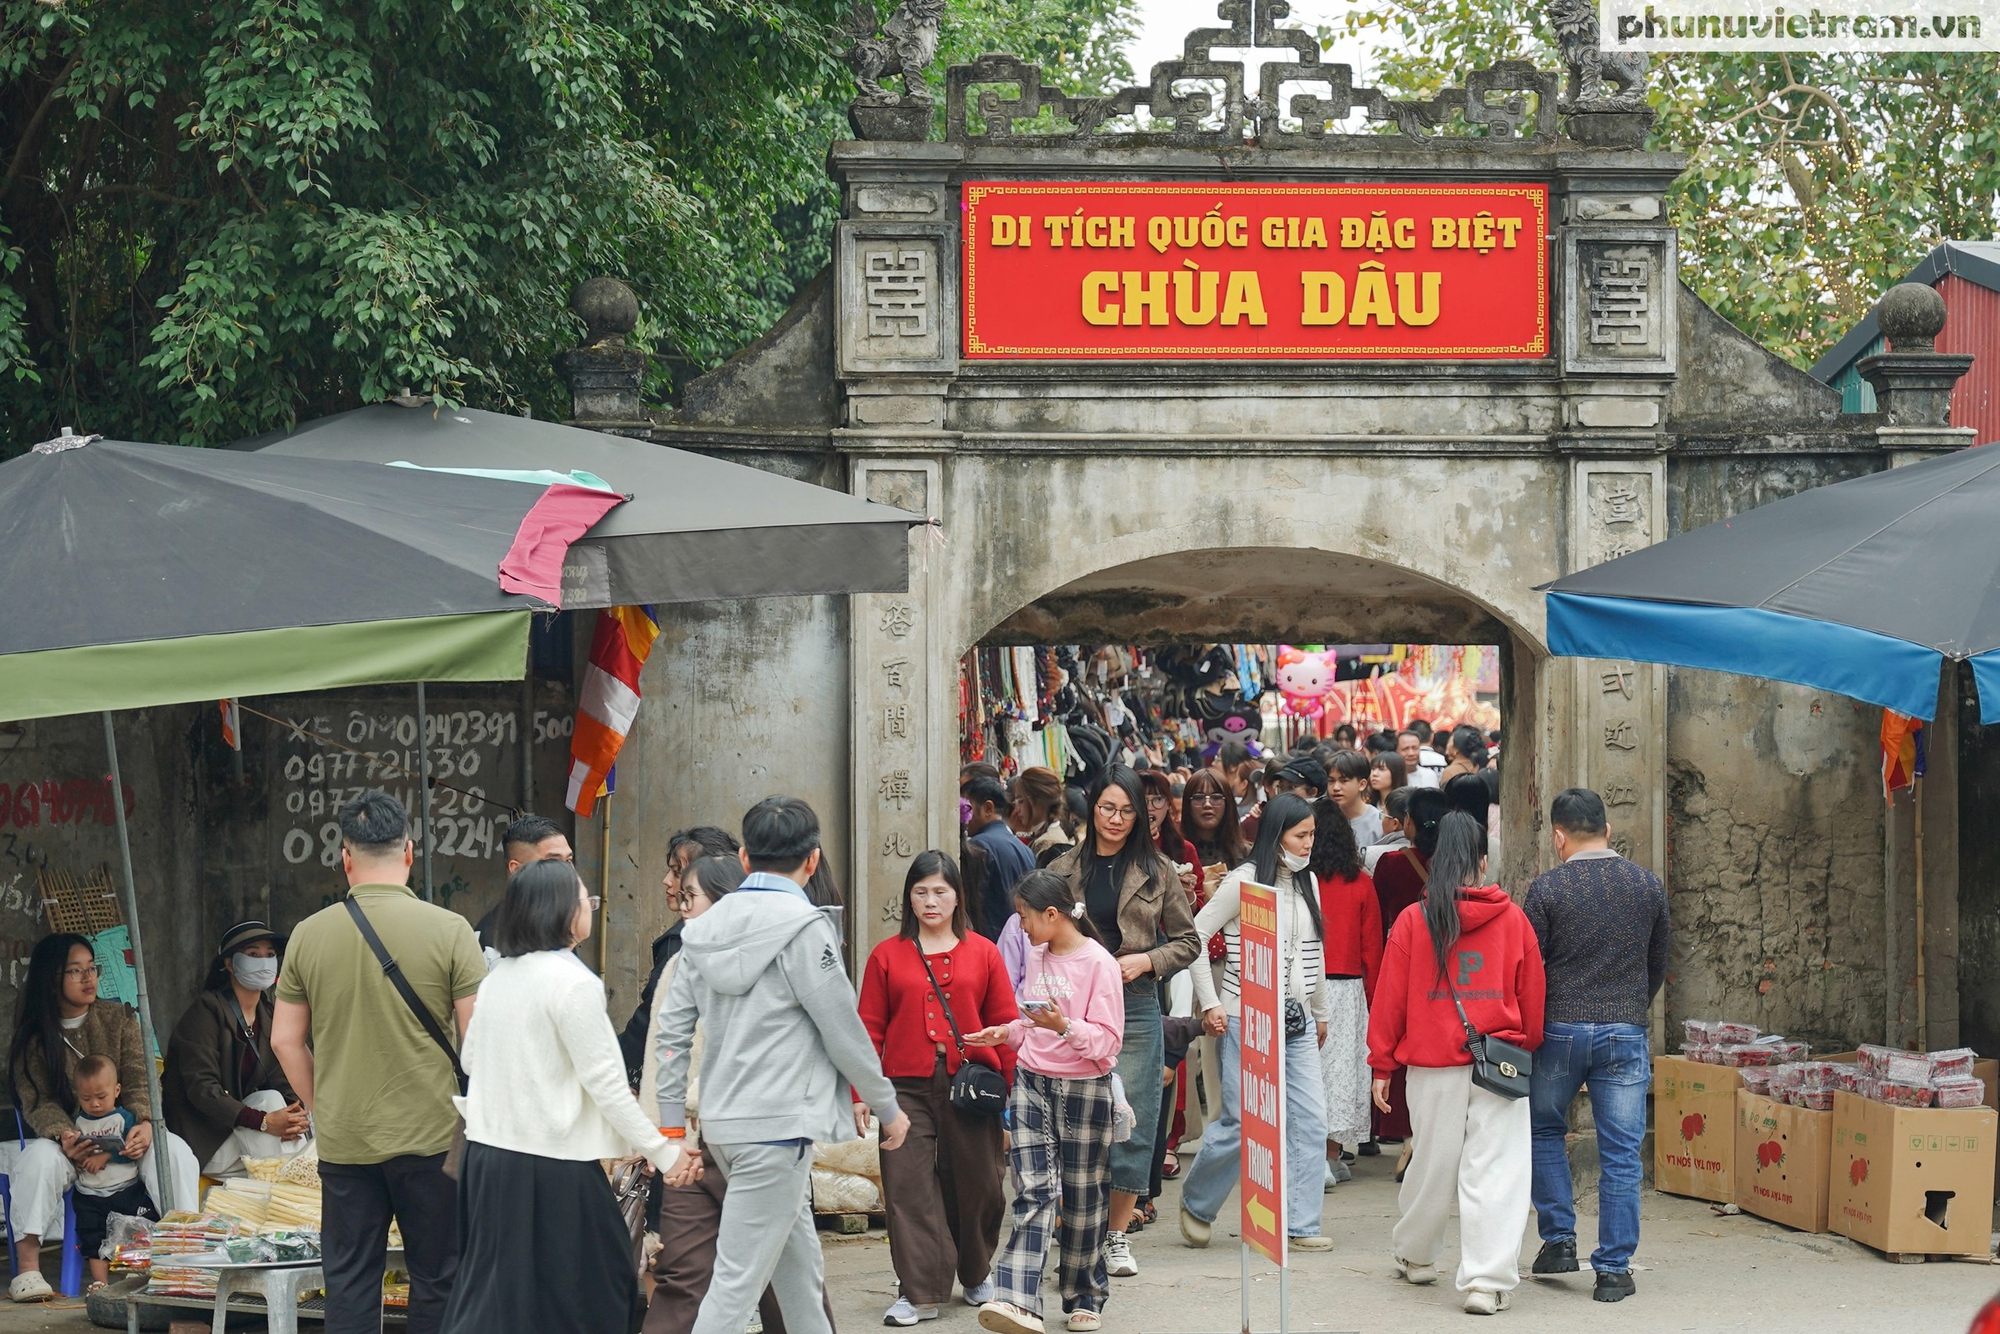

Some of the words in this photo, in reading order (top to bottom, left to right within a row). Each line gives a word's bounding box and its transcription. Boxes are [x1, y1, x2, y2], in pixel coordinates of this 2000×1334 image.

[991, 214, 1032, 247] DI
[1044, 206, 1136, 248] TÍCH
[1147, 201, 1249, 254] QUỐC
[1261, 217, 1328, 248] GIA
[1340, 210, 1416, 253] ĐẶC
[1432, 210, 1522, 254] BIỆT
[1081, 257, 1268, 326] CHÙA
[1301, 259, 1442, 326] DÂU
[1035, 972, 1066, 986] Have
[1244, 938, 1254, 983] XE
[1256, 937, 1272, 990] MÁY
[1457, 951, 1484, 985] P
[1244, 1004, 1254, 1049] XE
[1256, 1010, 1272, 1064] ĐẠP
[1243, 1063, 1258, 1117] VÀO
[1260, 1072, 1276, 1128] SÂN
[1247, 1137, 1274, 1194] TRONG
[1666, 1154, 1676, 1165] LA
